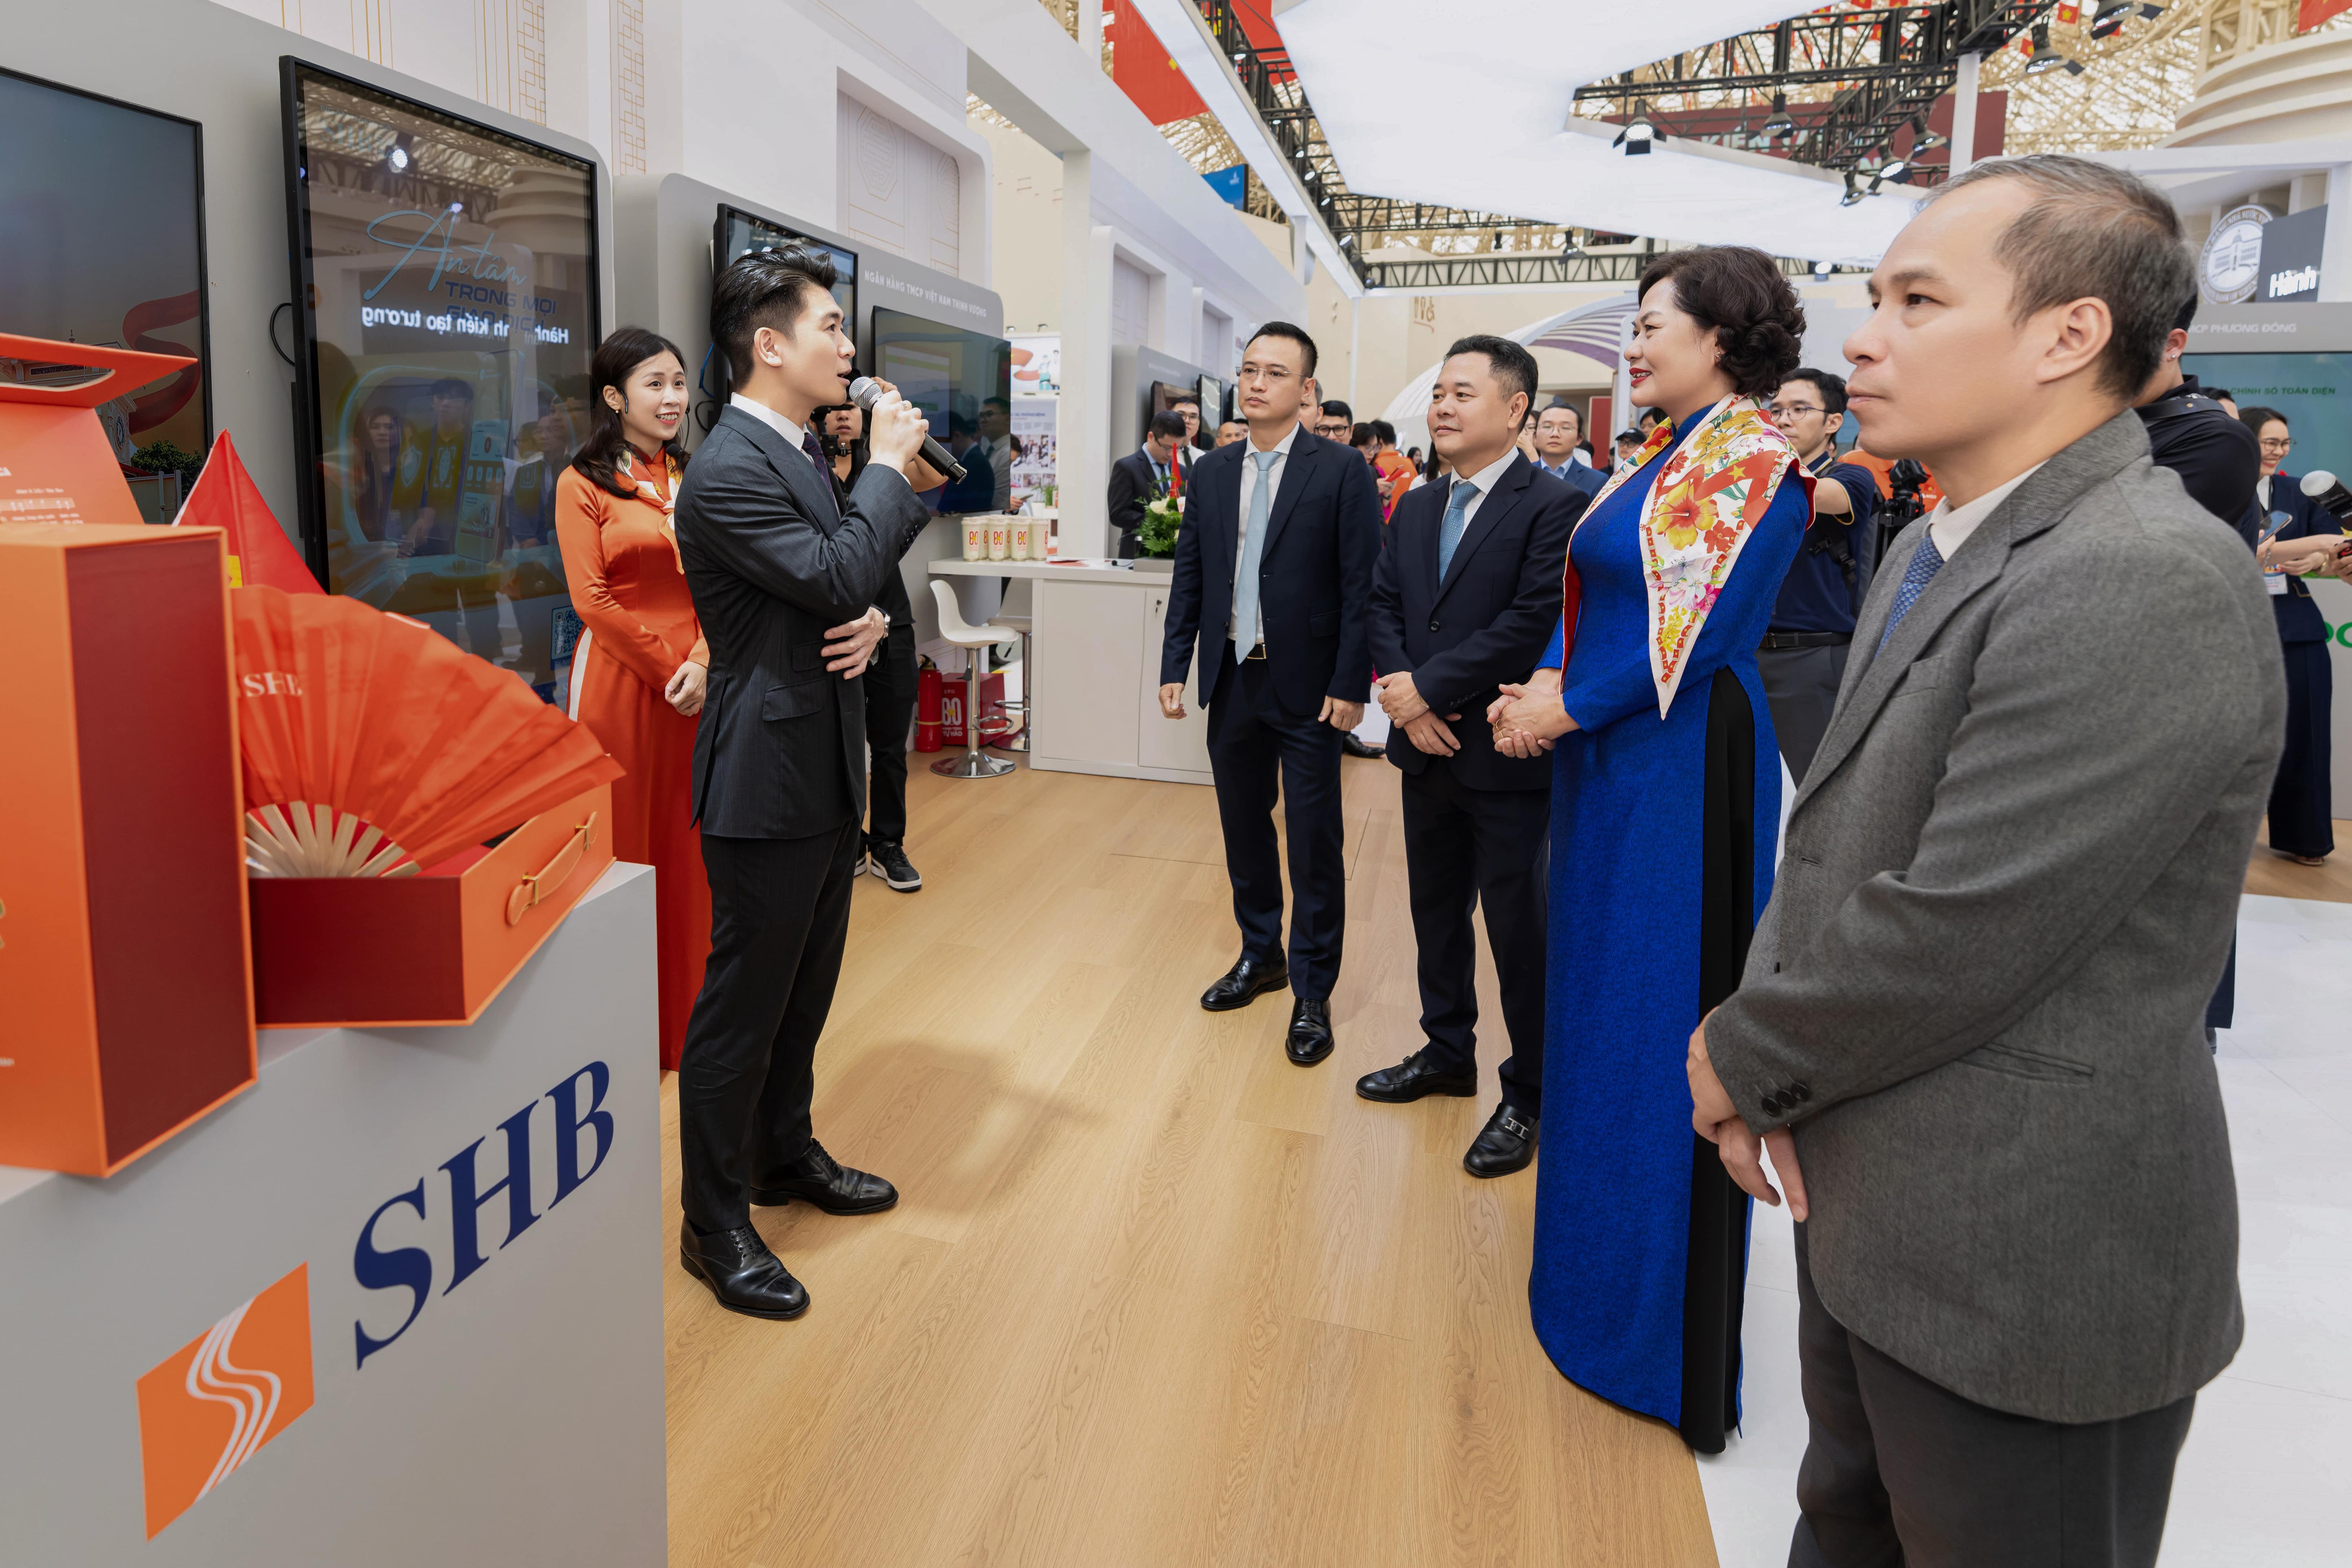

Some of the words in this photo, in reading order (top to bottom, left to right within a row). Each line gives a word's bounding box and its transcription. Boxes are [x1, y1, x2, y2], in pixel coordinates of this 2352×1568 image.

[445, 280, 518, 308] TRONG
[523, 295, 557, 315] MỌI
[865, 270, 884, 286] NGÂN
[887, 275, 904, 292] HÀNG
[906, 284, 923, 297] TMCP
[925, 289, 937, 303] VIỆT
[939, 294, 951, 306] NAM
[2269, 265, 2316, 298] Hành
[969, 531, 978, 545] 80
[993, 531, 1003, 545] 80
[1017, 531, 1026, 545] 80
[354, 1061, 614, 1371] SHB
